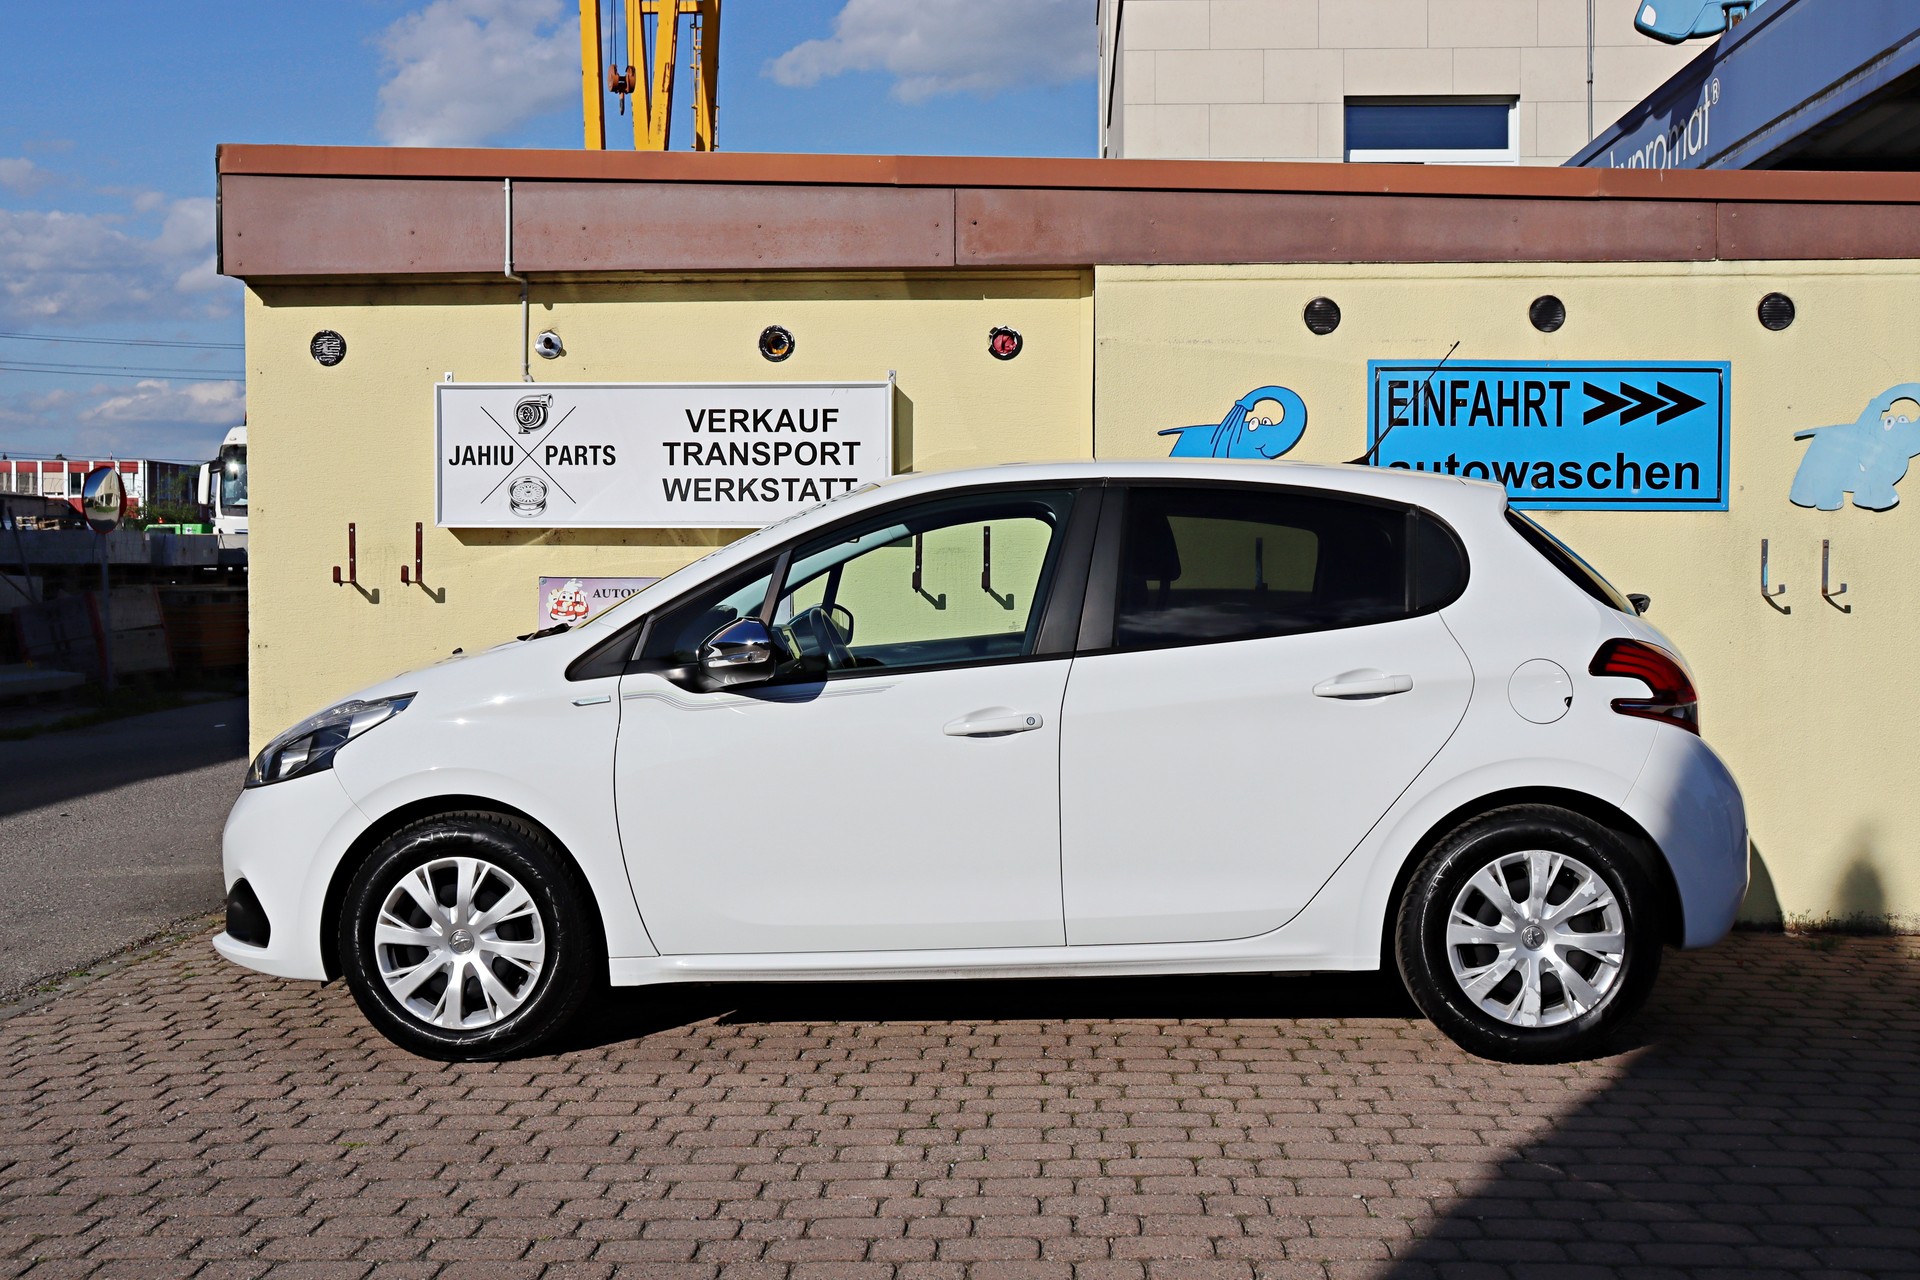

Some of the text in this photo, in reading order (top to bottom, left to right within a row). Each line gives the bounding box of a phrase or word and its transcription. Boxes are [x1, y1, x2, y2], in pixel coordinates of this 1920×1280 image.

[1388, 380, 1570, 427] EINFAHRT
[685, 409, 839, 433] VERKAUF
[449, 445, 616, 467] JAHIU PARTS
[662, 442, 861, 466] TRANSPORT
[1388, 453, 1699, 489] towaschen
